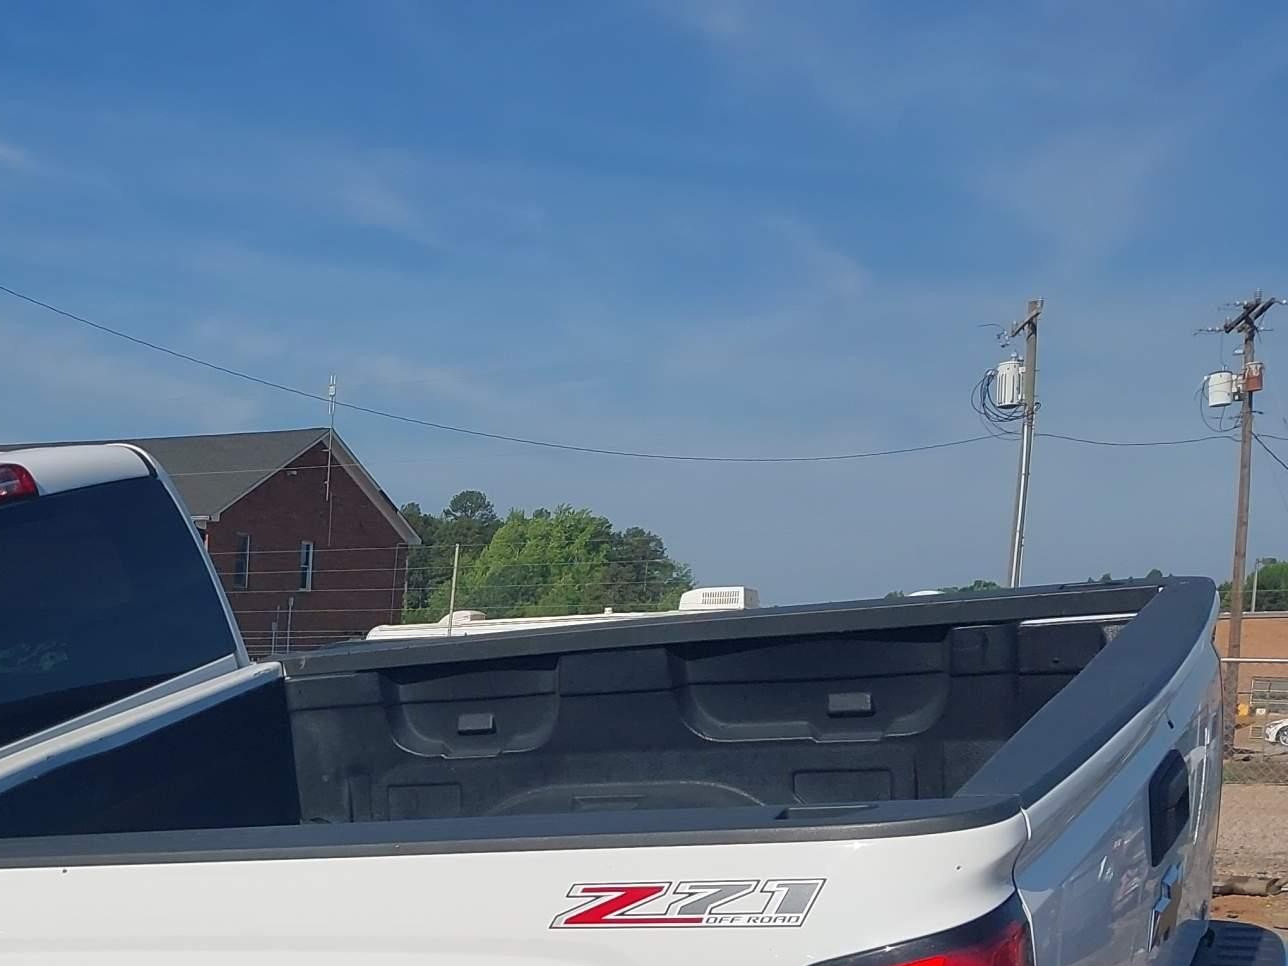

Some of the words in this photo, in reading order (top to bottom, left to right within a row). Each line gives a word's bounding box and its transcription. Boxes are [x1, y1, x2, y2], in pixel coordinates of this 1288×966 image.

[549, 878, 827, 929] Z71
[705, 915, 743, 925] OFF
[746, 915, 801, 925] ROAD
